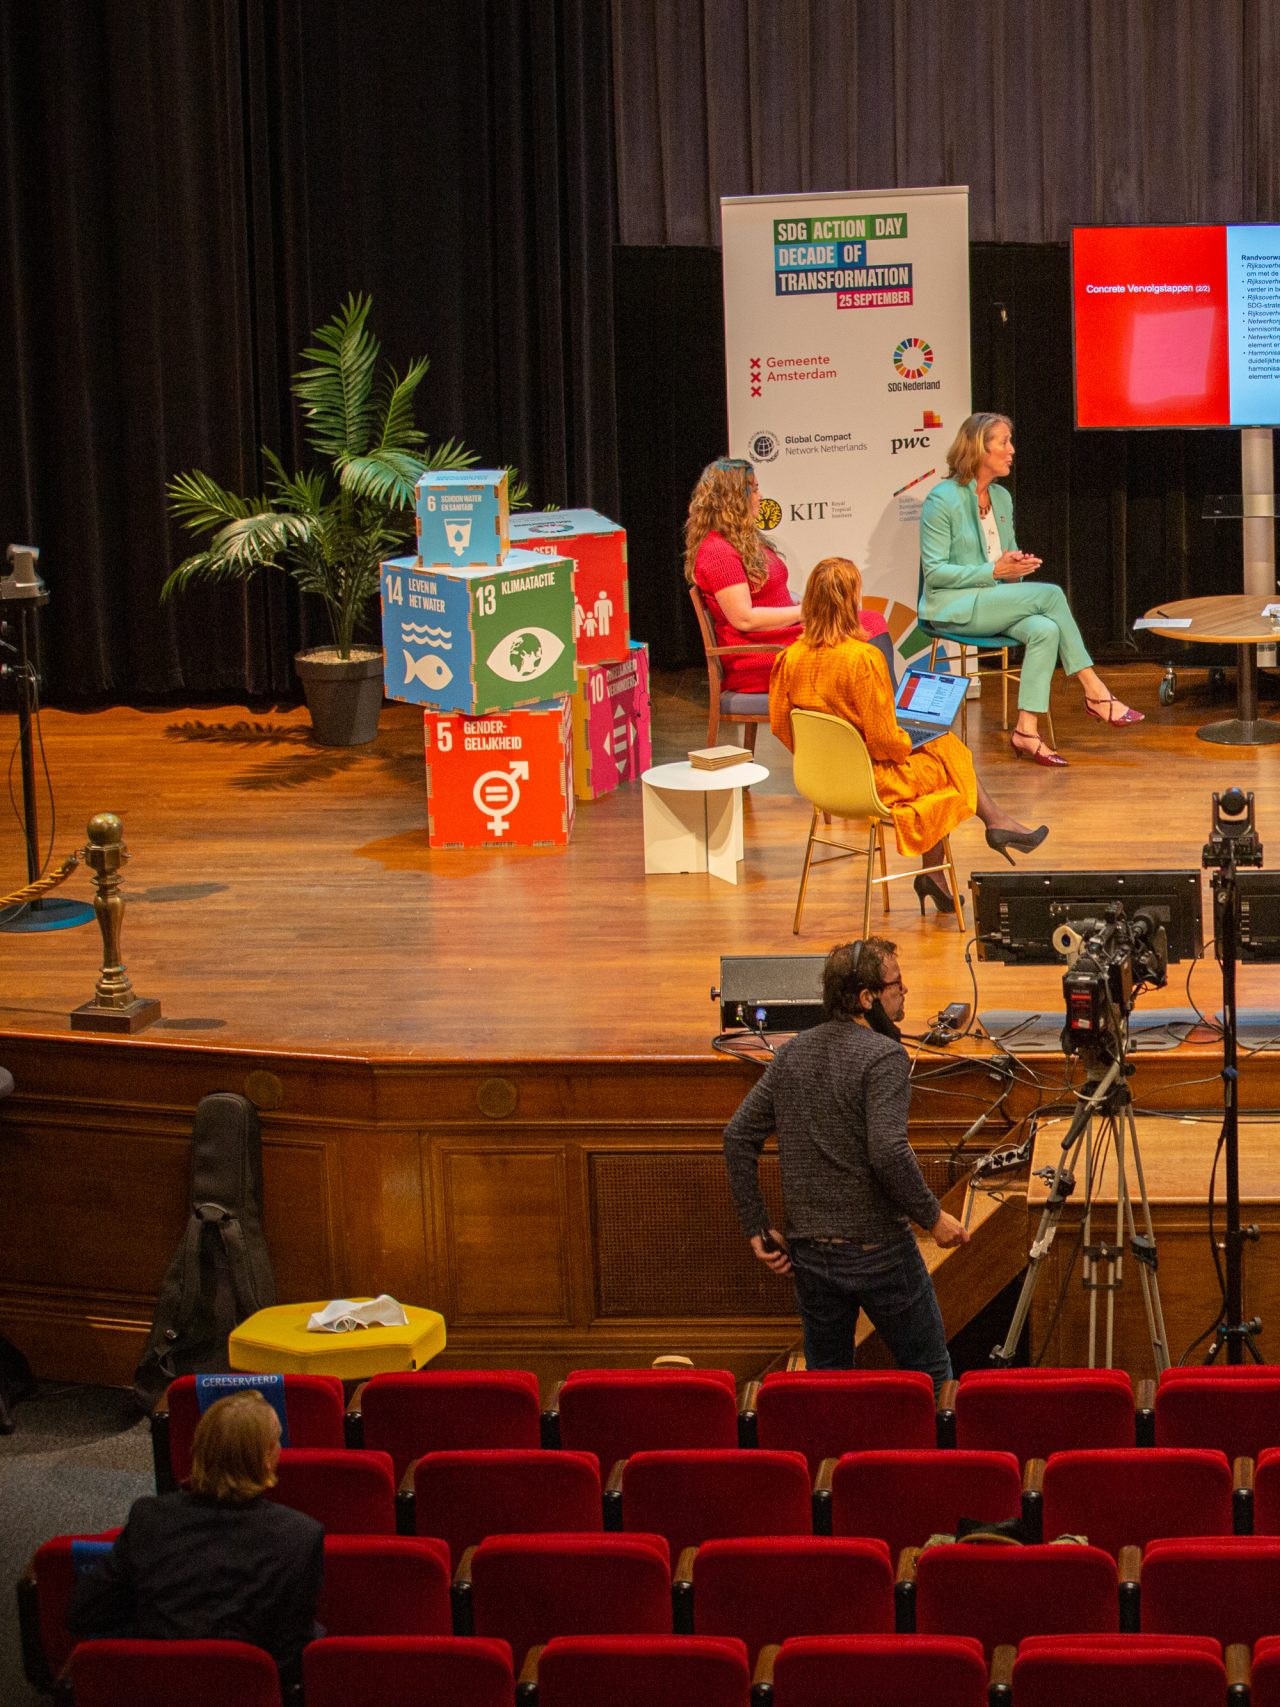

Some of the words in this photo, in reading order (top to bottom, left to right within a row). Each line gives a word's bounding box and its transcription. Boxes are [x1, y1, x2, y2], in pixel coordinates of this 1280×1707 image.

[778, 223, 807, 241] SDG
[814, 219, 865, 239] ACTION
[875, 218, 902, 236] DAY
[779, 246, 834, 266] DECADE
[844, 244, 862, 263] OF
[779, 267, 908, 291] TRANSFORMATION
[1086, 285, 1125, 293] Concrete
[1128, 284, 1193, 294] Vervolgstappen
[840, 294, 852, 306] 25
[854, 291, 910, 306] SEPTEMBER
[767, 356, 830, 368] Gemeente
[767, 368, 837, 381] Amsterdam
[888, 383, 902, 392] SDG
[903, 380, 940, 391] Nederland
[785, 435, 812, 444] Global
[814, 433, 851, 442] Compact
[891, 436, 930, 454] pwc
[785, 446, 818, 455] Network
[820, 443, 867, 453] Netherlands
[428, 496, 435, 512] 6
[790, 502, 828, 521] KIT
[386, 575, 403, 606] 14
[408, 578, 430, 593] LEVEN
[430, 582, 437, 595] IN
[502, 572, 555, 595] KLIMAATACTIE
[410, 595, 422, 608] HET
[422, 597, 445, 613] WATER
[476, 584, 496, 616] 13
[591, 673, 604, 704] 10
[464, 721, 507, 734] GENDER-
[437, 722, 452, 752] 5
[464, 736, 522, 750] GELIJKHEID
[202, 1376, 278, 1387] GERESERVEERD
